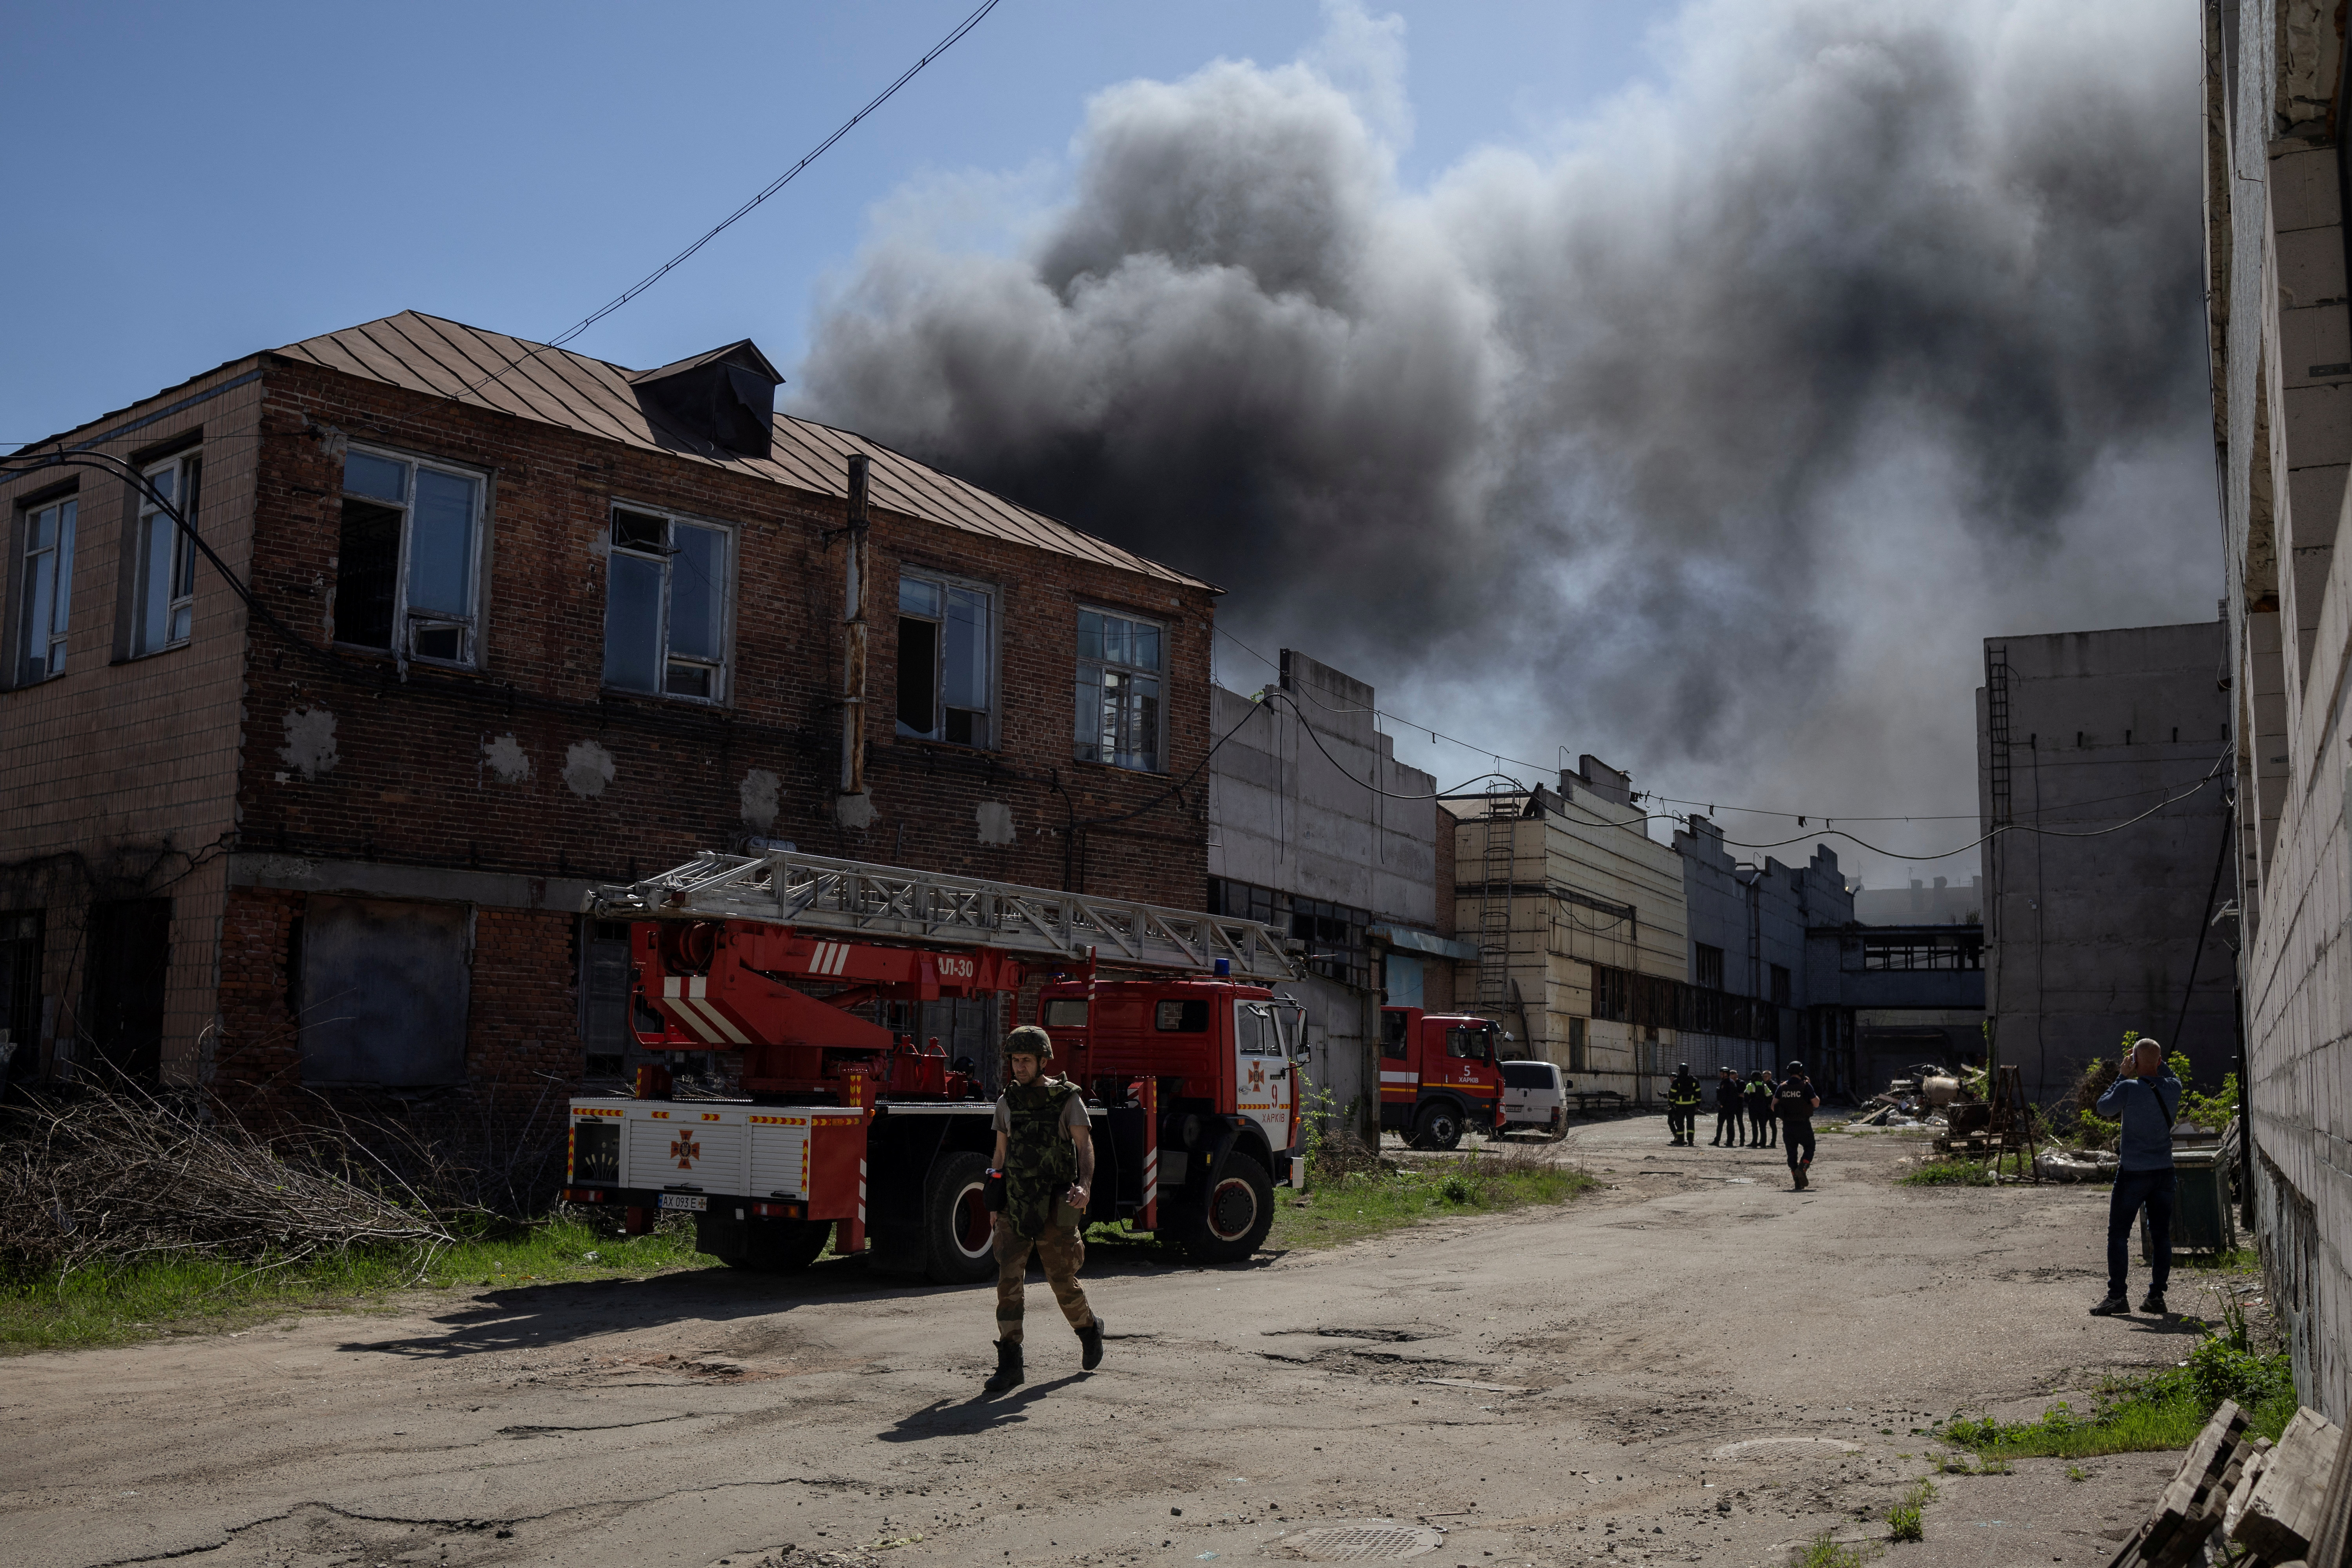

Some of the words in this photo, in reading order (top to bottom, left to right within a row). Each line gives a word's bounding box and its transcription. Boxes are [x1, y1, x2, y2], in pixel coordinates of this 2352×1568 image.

[938, 957, 973, 977] АЛ-30
[1464, 1065, 1470, 1076] 5
[1271, 1084, 1278, 1109] 9
[675, 1197, 689, 1208] 093
